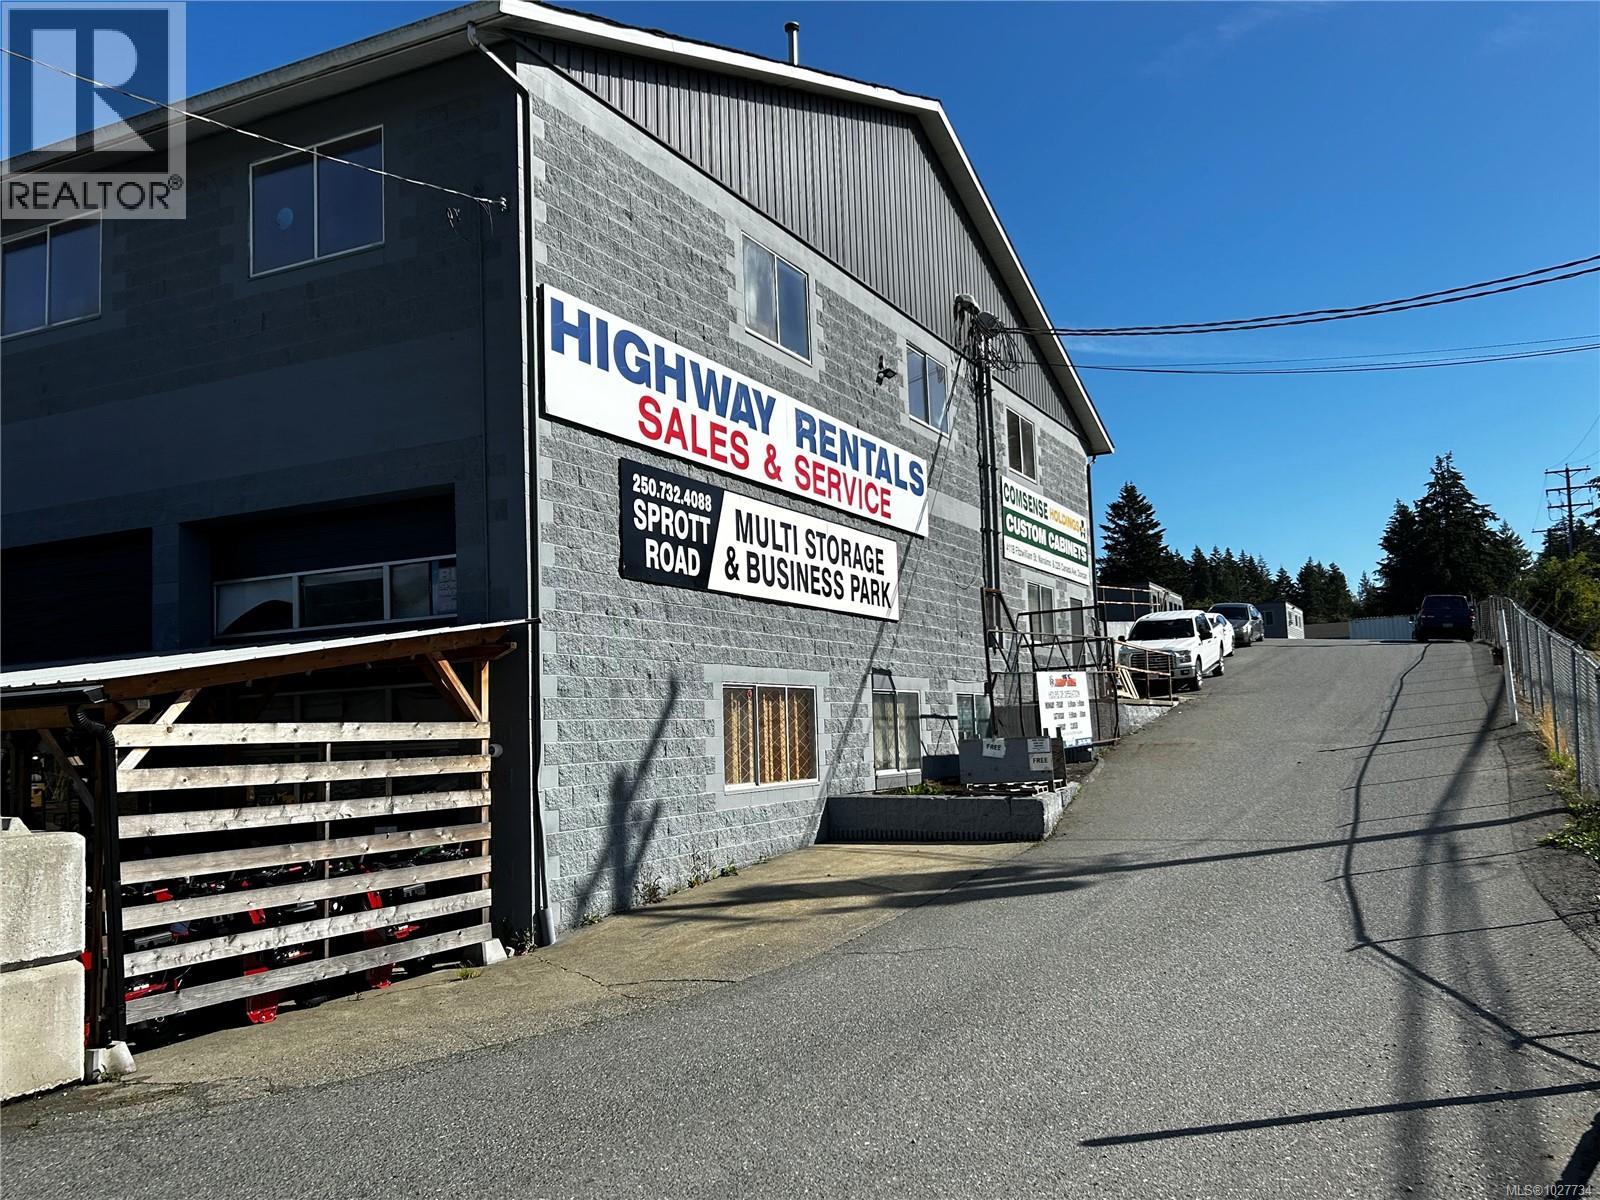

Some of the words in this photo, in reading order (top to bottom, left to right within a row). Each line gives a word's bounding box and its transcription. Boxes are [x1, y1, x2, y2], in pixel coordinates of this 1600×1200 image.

[551, 297, 776, 435] HIGHWAY
[795, 408, 925, 497] RENTALS
[638, 395, 749, 470] SALES
[764, 444, 782, 482] &
[794, 455, 891, 519] SERVICE
[632, 473, 712, 512] 250.732.4088
[1003, 482, 1048, 520] COMSENSE
[1049, 506, 1080, 533] HOLDINGS
[633, 498, 711, 544] SPROTT
[735, 509, 798, 555] MULTI
[805, 528, 884, 575] STORAGE
[1006, 513, 1047, 546] CUSTOM
[1048, 532, 1087, 562] CABINETS
[645, 538, 700, 577] ROAD
[725, 546, 740, 581] &
[746, 551, 844, 600] BUSINESS
[851, 574, 892, 608] PARK
[986, 743, 1001, 751] FREE
